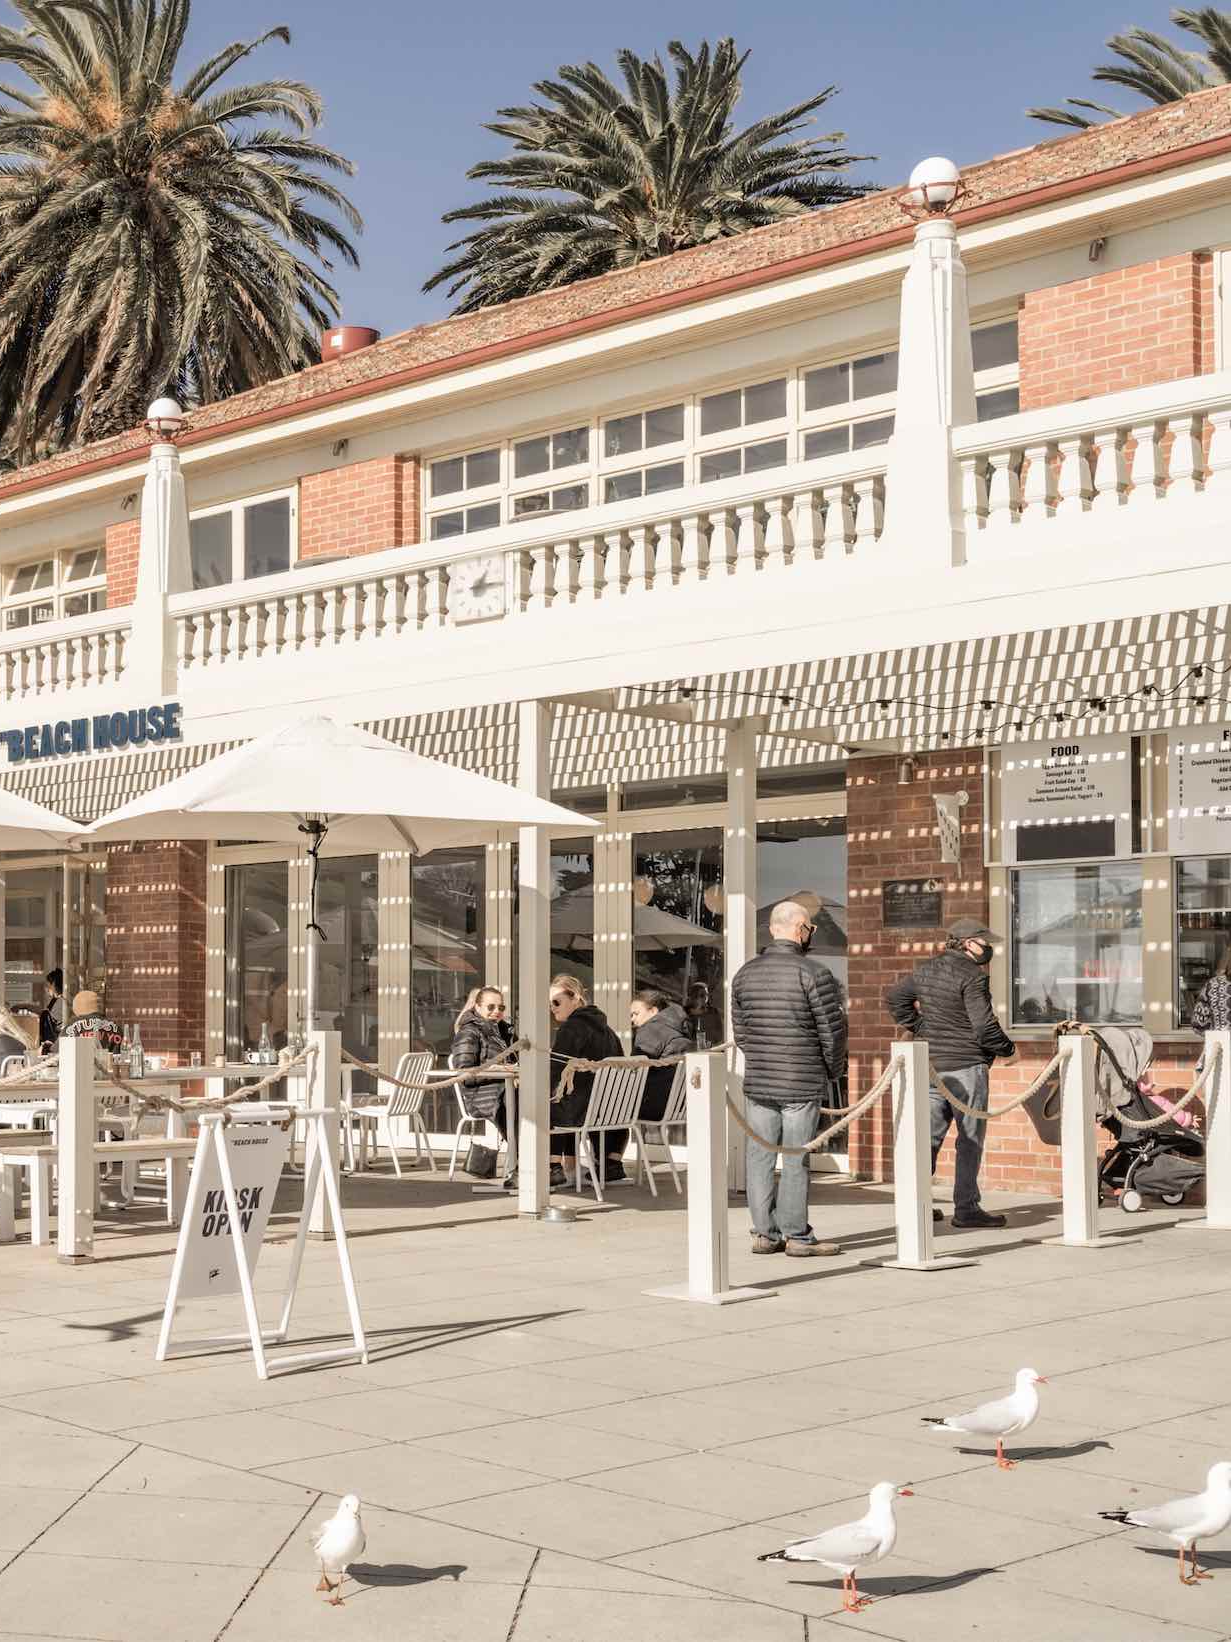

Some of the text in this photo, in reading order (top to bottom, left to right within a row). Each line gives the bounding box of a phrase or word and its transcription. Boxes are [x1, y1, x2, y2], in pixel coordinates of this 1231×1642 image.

[93, 702, 180, 749] HOUSE
[1051, 745, 1079, 757] FOOD
[201, 1211, 253, 1238] OPN
